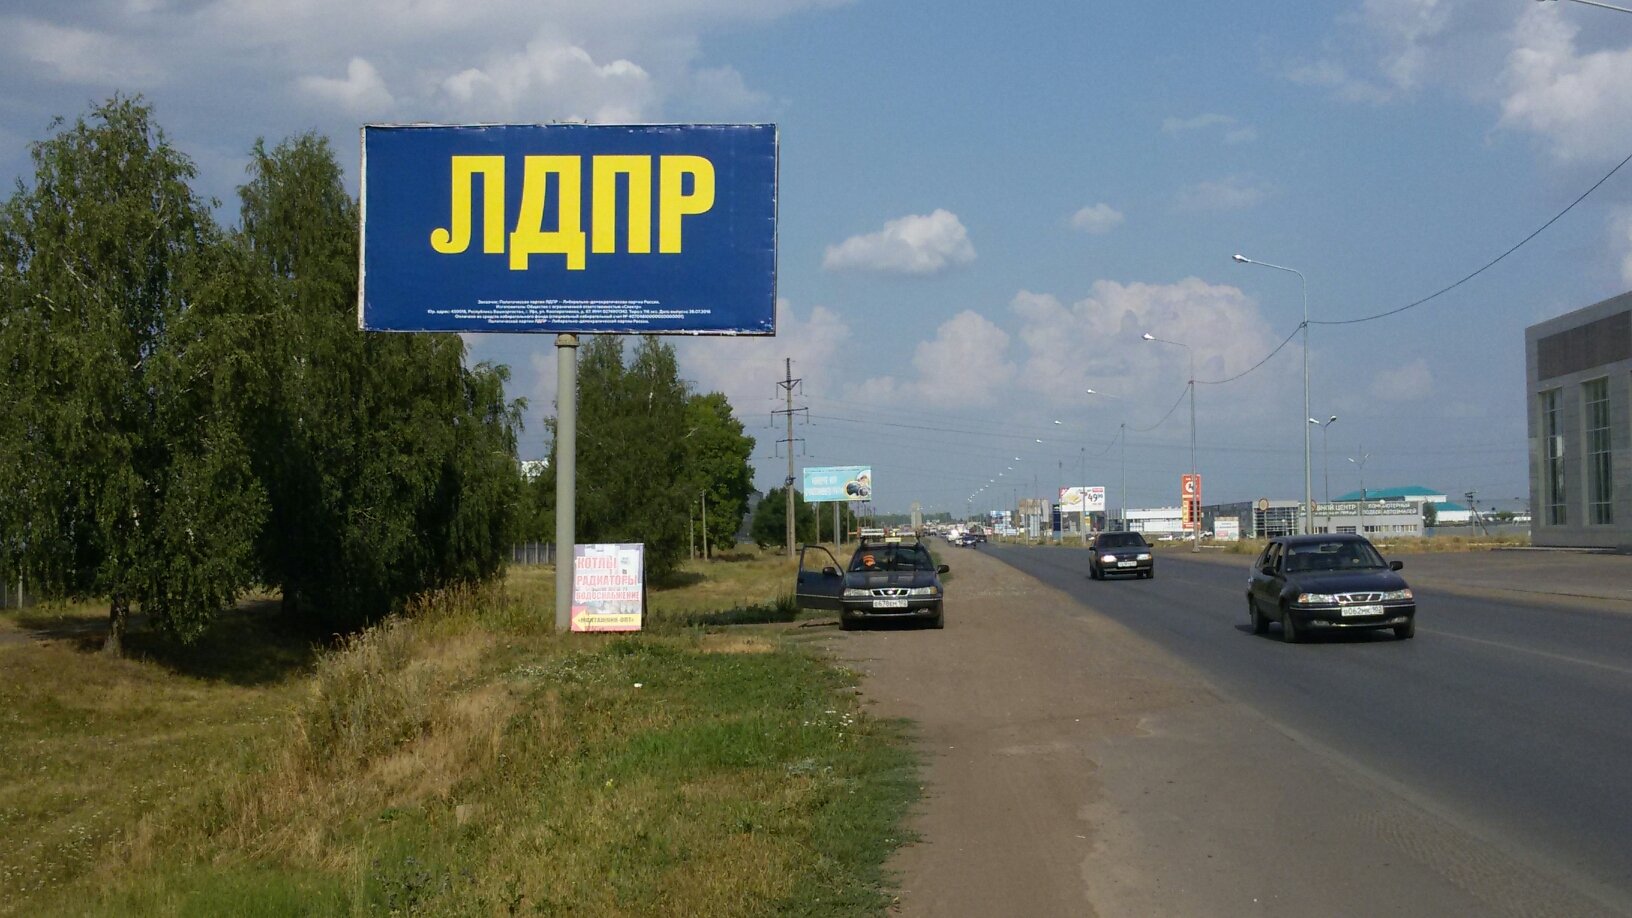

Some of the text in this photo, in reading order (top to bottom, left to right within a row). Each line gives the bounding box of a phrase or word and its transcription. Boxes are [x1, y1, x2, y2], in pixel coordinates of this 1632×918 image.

[430, 155, 716, 271] ЛДПР
[577, 557, 616, 569] КОТЛЫ
[576, 575, 637, 586] РАДИАТОРЫ
